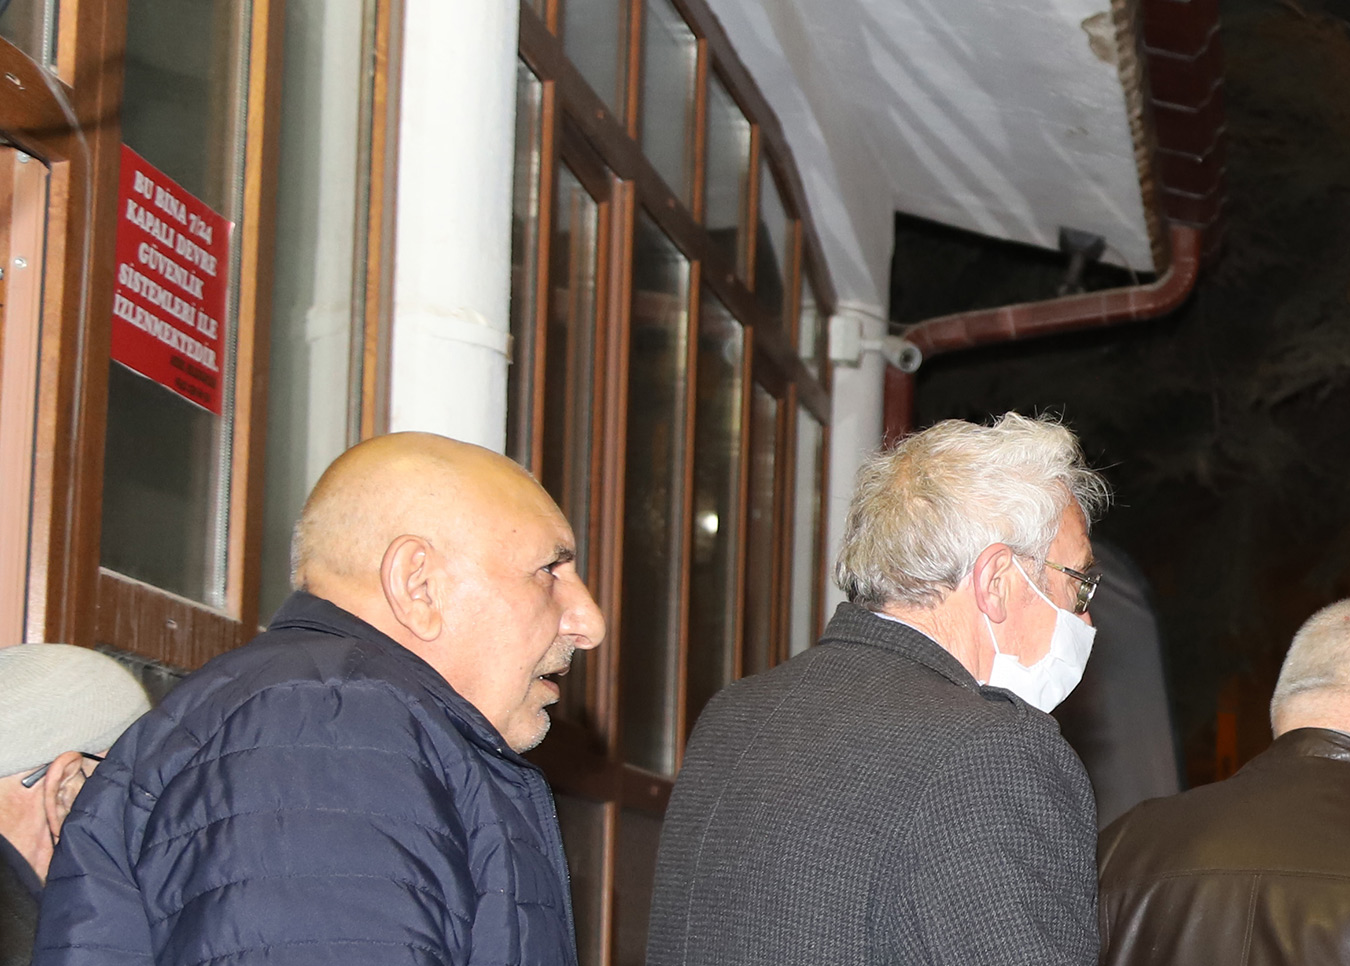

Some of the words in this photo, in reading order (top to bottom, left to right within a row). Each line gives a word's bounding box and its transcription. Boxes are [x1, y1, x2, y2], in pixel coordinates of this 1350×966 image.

[126, 199, 174, 248] KAPALI
[176, 233, 217, 277] DEVRE
[134, 170, 154, 200] BU
[154, 187, 187, 225] BİNA
[188, 211, 212, 246] 7/24
[118, 263, 196, 327] SİSTEMLERİ
[197, 307, 218, 340] İLE
[138, 242, 203, 299] GÜVENLİK
